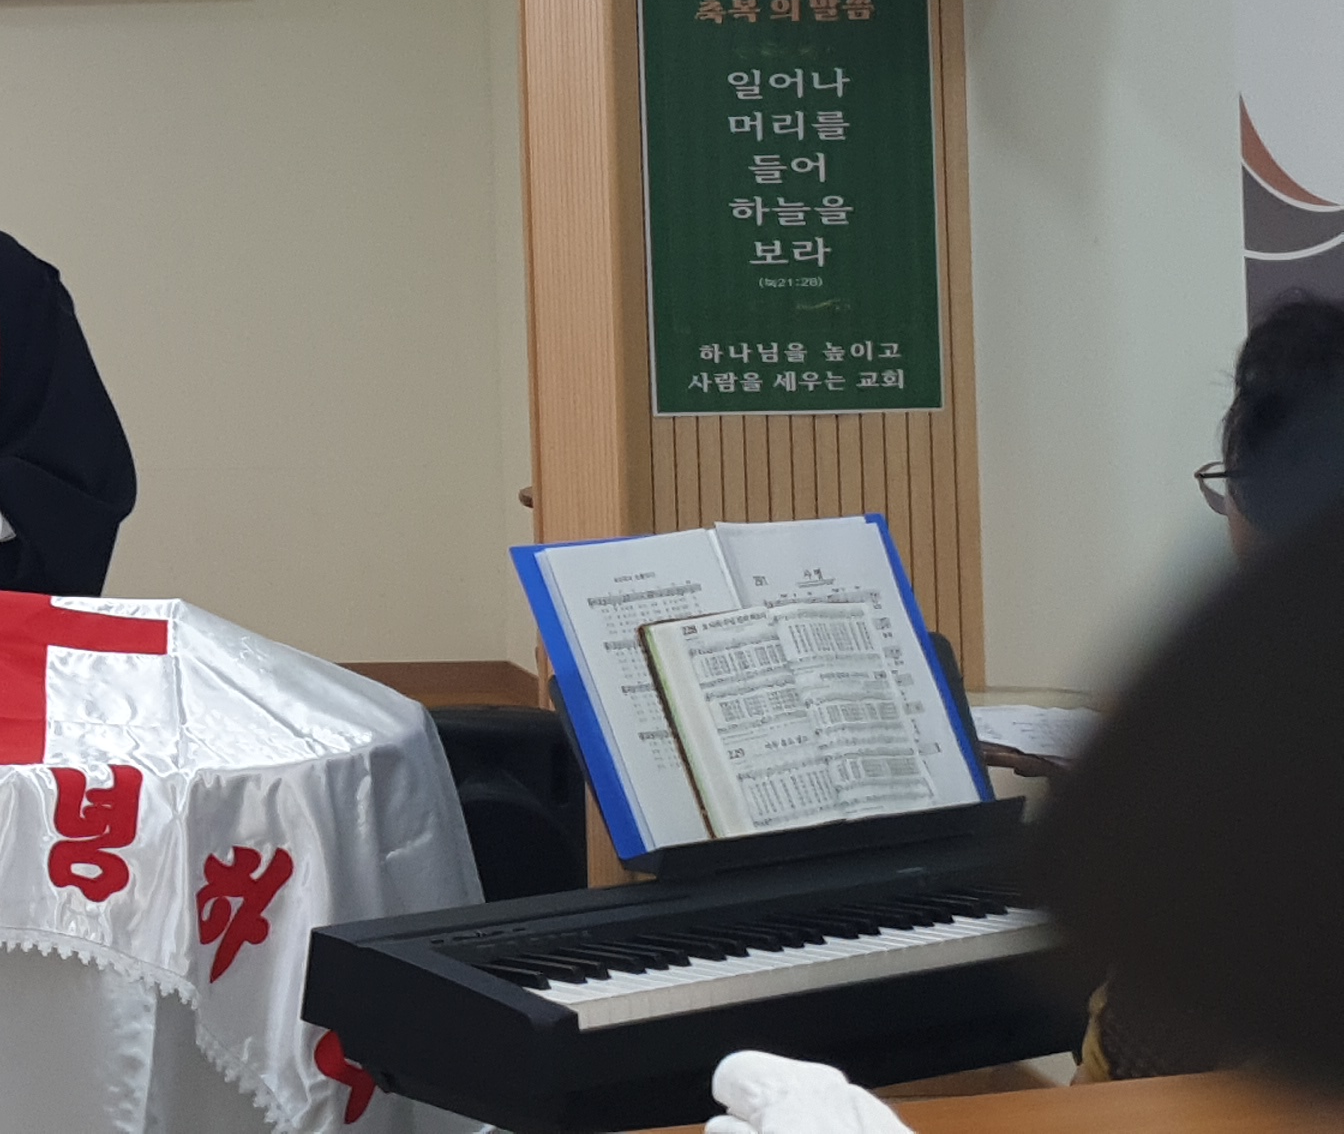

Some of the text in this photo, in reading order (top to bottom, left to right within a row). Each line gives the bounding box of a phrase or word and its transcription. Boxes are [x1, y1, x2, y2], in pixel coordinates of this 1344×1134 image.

[727, 67, 851, 100] 일어나
[727, 110, 851, 142] 머리를
[747, 152, 827, 184] 들어
[728, 195, 854, 226] 하늘을
[748, 236, 832, 268] 보라
[698, 340, 902, 364] 하나님을 높이고
[687, 368, 905, 393] 사람을 세우는 교회
